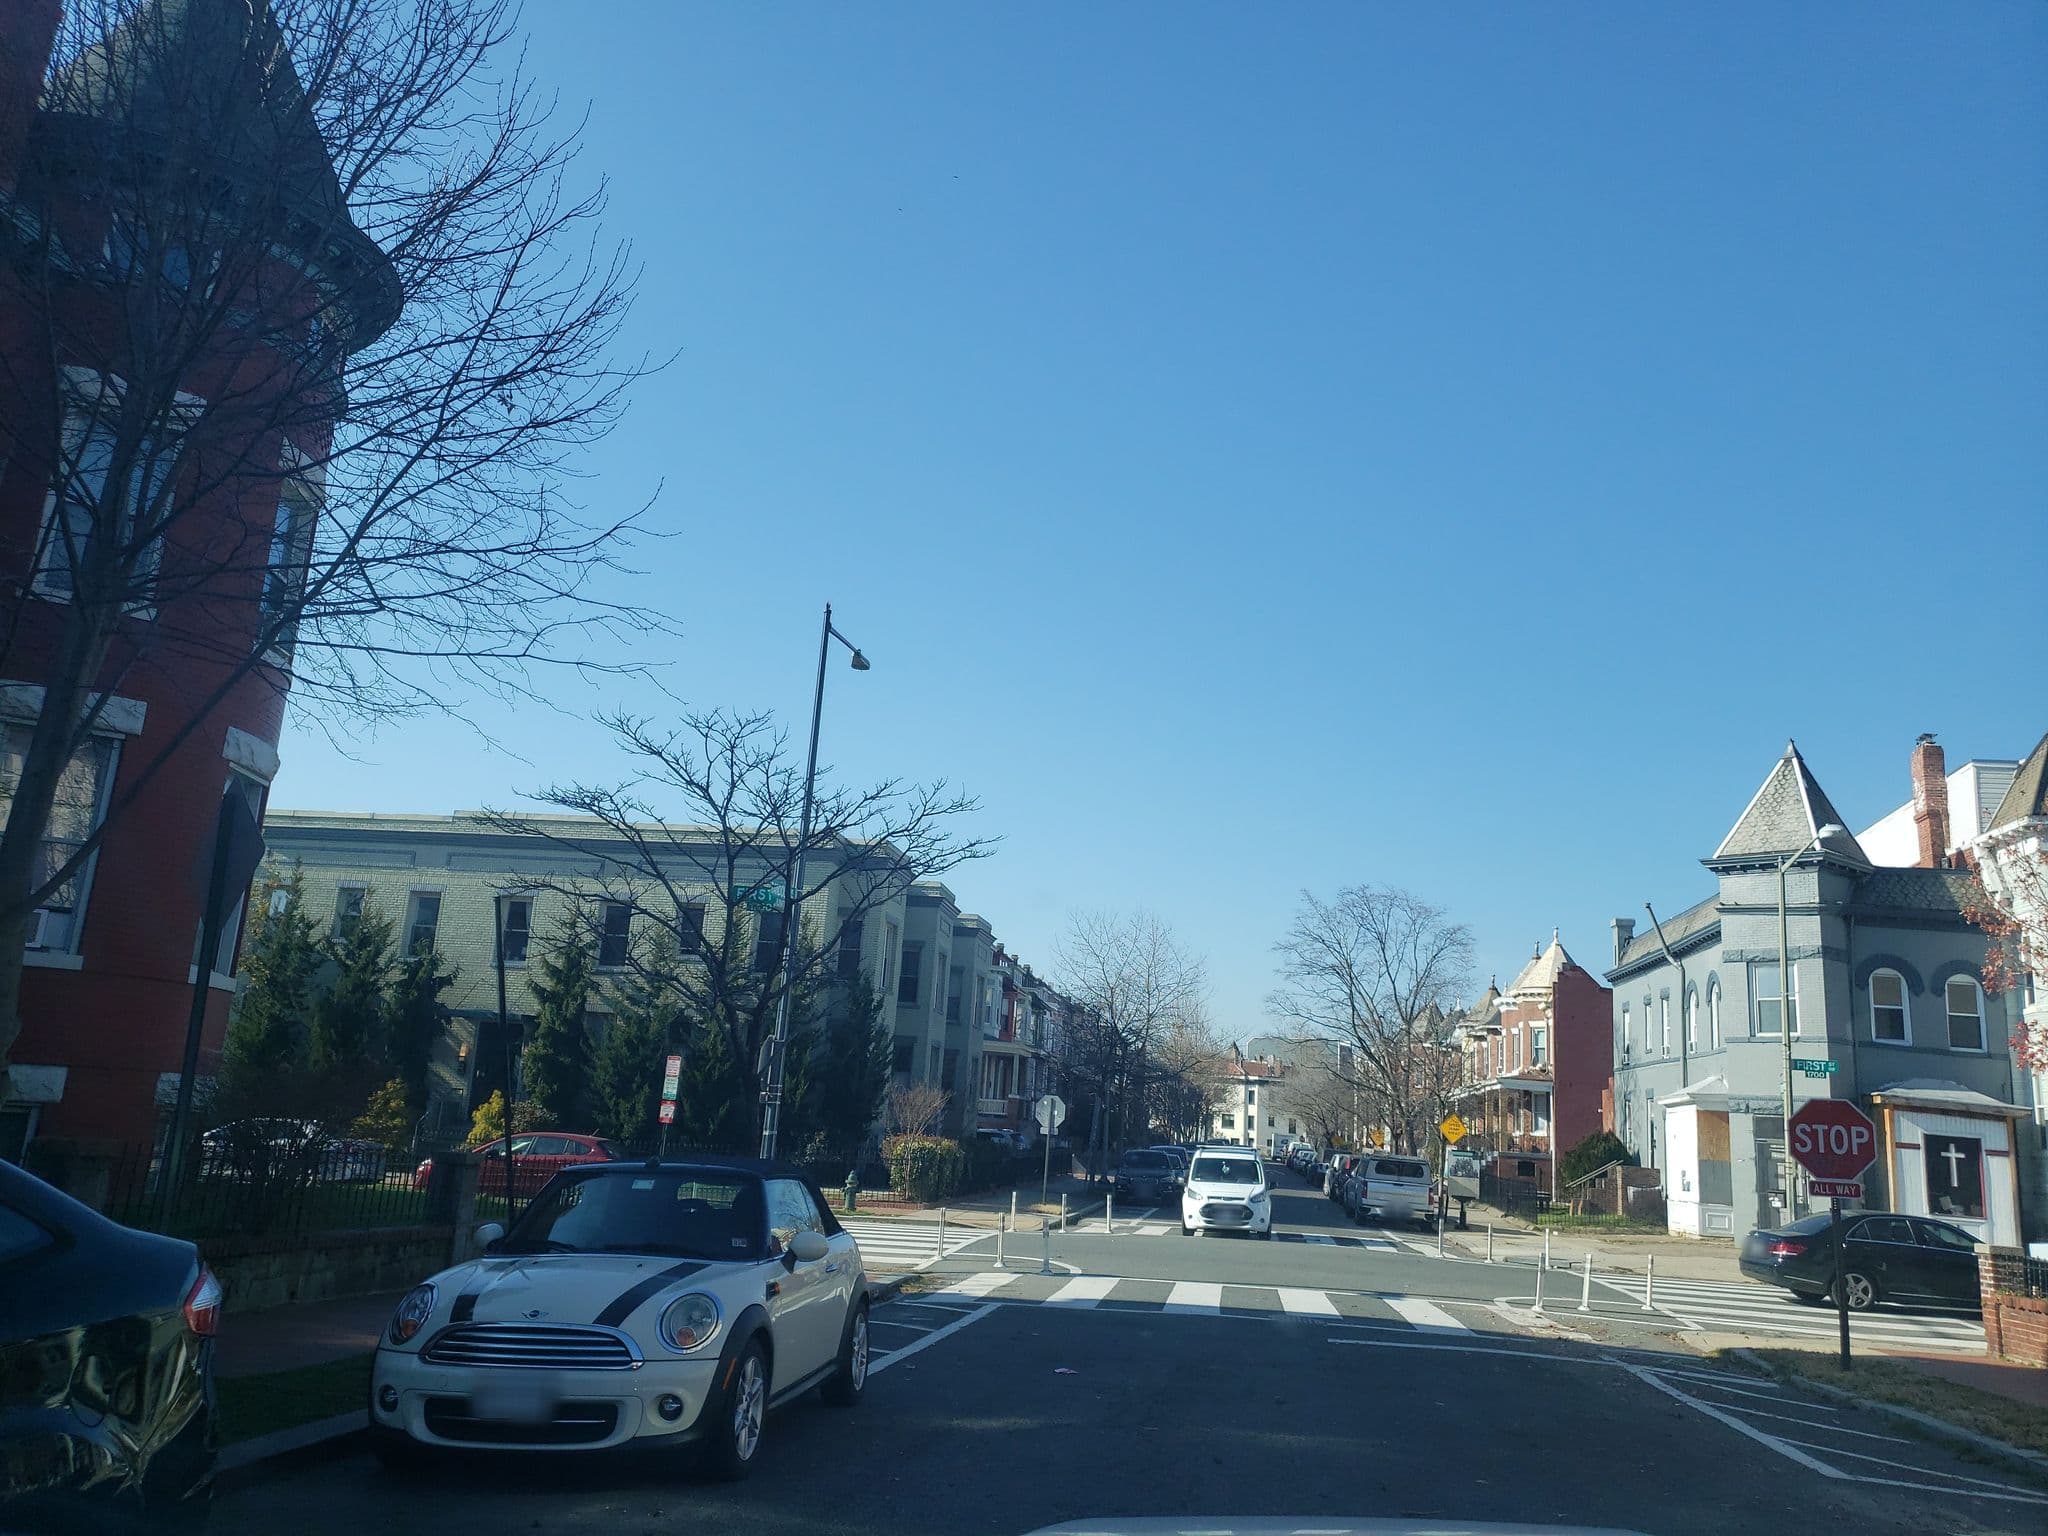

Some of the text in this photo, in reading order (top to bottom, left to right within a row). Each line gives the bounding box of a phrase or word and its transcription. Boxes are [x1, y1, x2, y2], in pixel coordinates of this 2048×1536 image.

[736, 887, 773, 901] FRST
[1796, 1060, 1827, 1071] FIRST
[1794, 1123, 1870, 1155] STOP
[1813, 1183, 1857, 1196] ALL WAY
